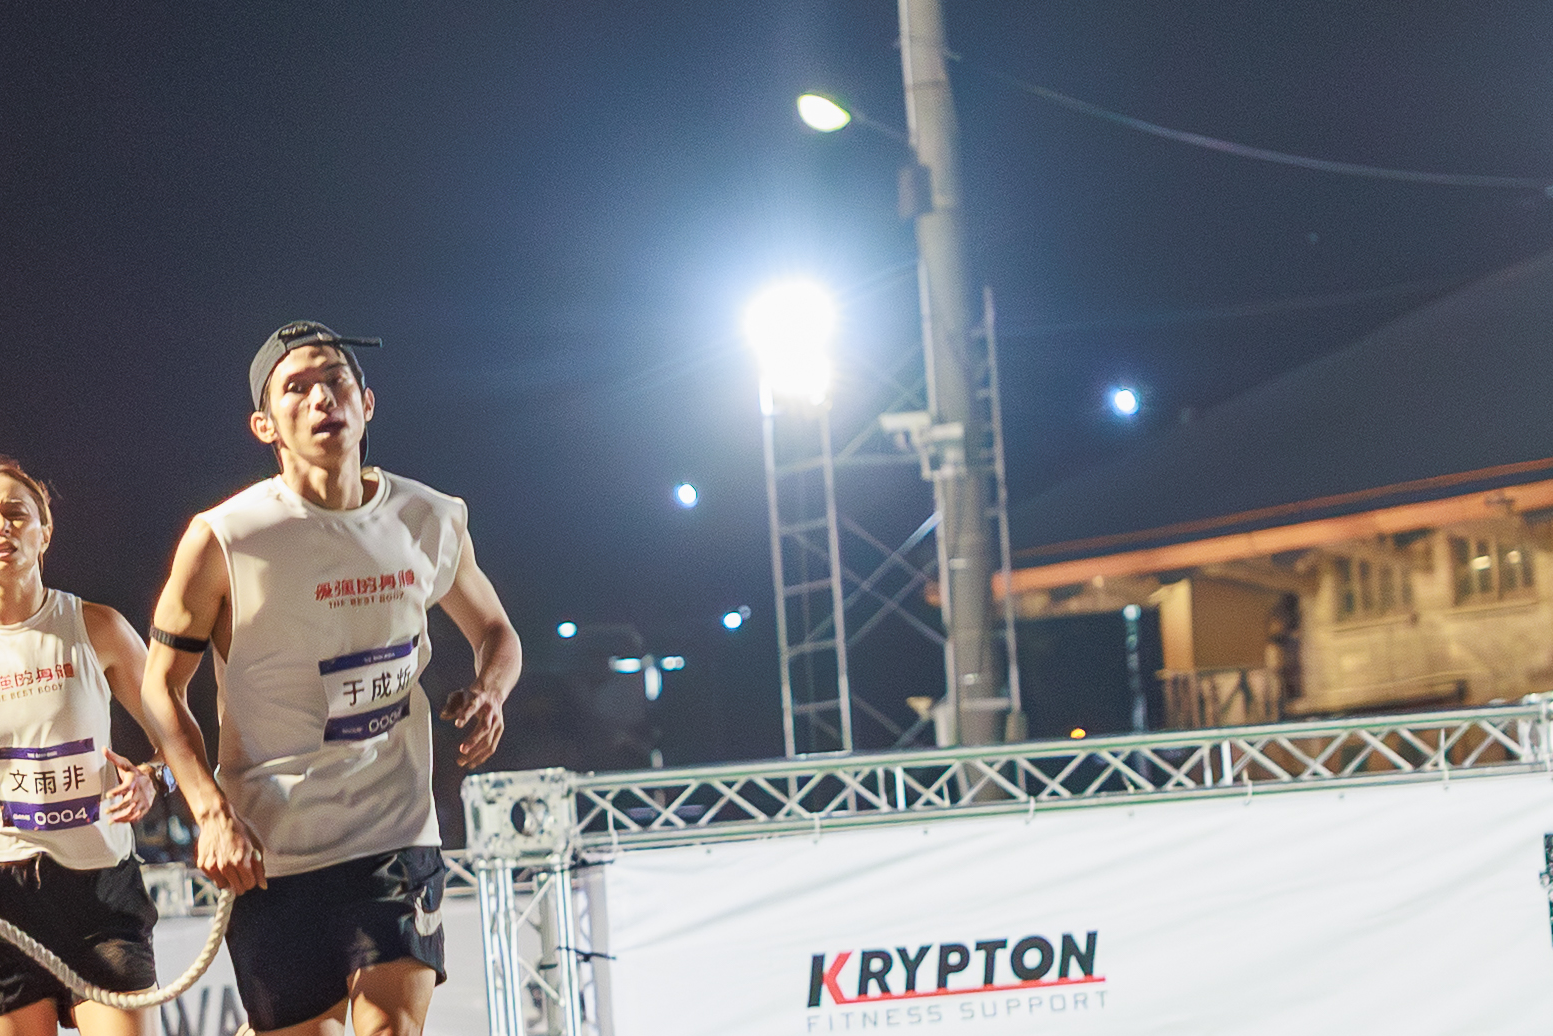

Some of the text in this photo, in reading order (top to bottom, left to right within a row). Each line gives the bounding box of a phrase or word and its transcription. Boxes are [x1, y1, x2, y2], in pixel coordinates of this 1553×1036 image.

[10, 688, 33, 700] BEST
[38, 682, 64, 694] BODY
[9, 765, 86, 794] 文雨非
[34, 807, 89, 826] 0004
[807, 930, 1099, 1009] KRYPTON
[807, 990, 1109, 1033] FITNESS SUPPORT
